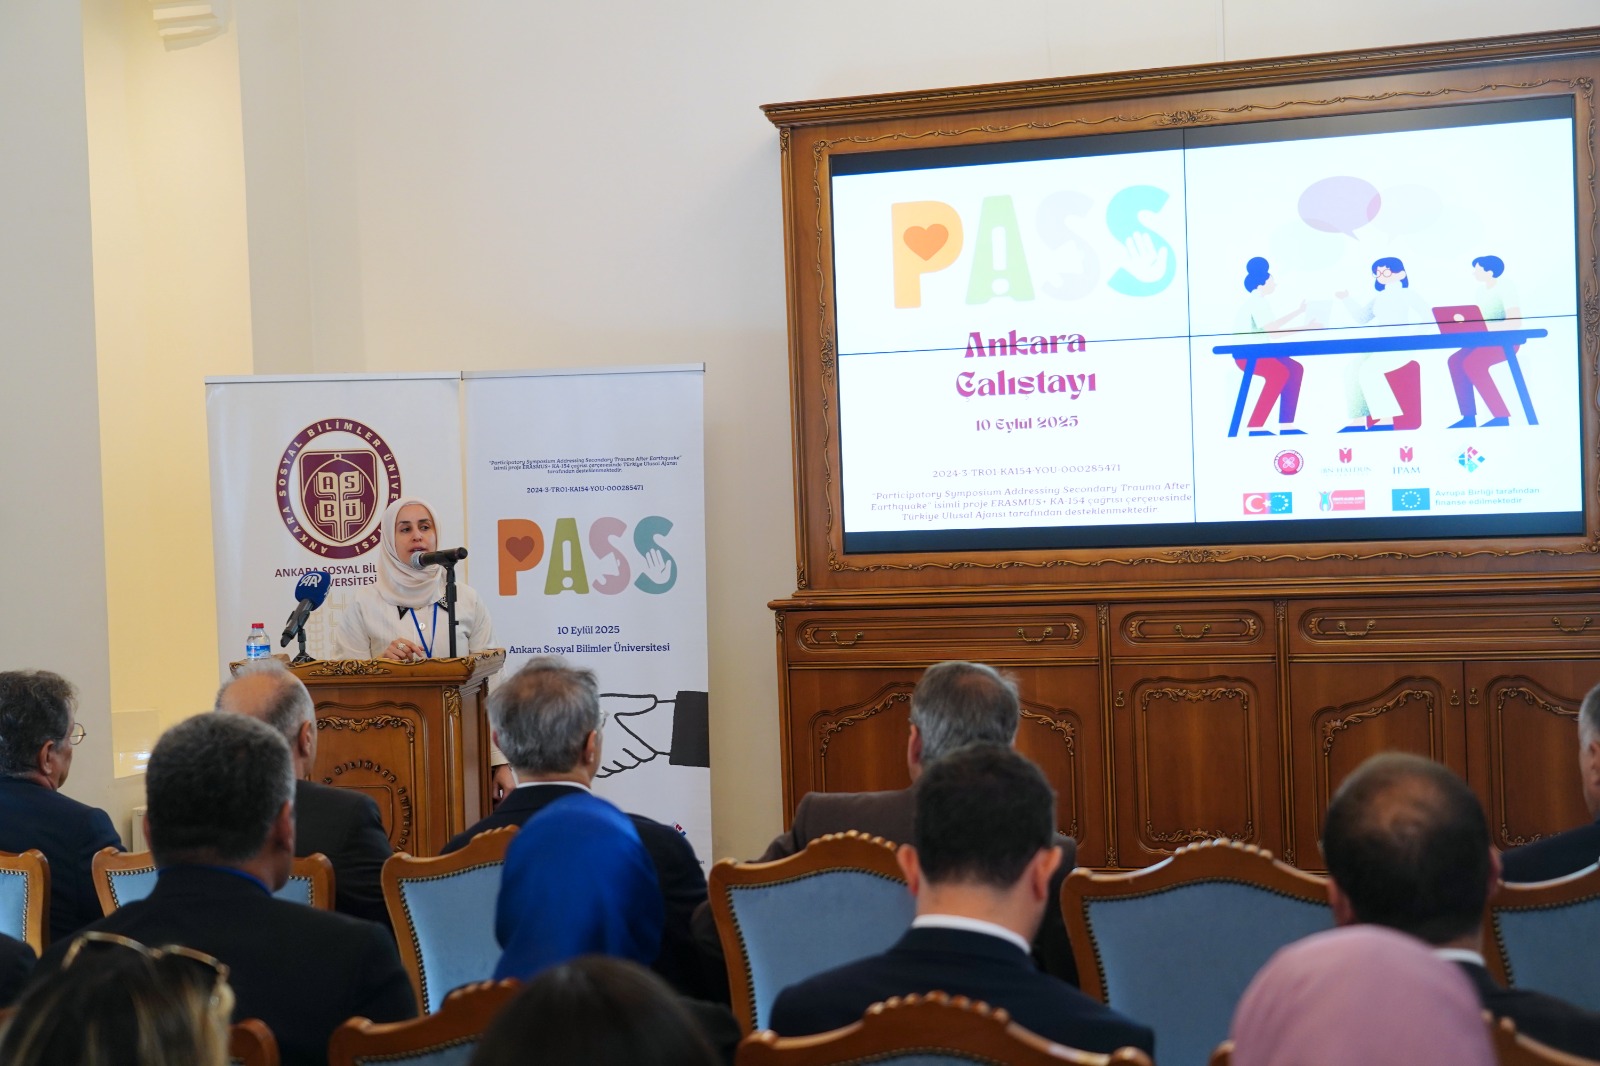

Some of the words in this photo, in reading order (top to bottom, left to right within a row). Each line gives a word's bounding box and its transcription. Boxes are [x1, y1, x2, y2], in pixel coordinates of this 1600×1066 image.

[891, 185, 1177, 309] PASS
[964, 329, 1086, 358] Ankara
[306, 419, 382, 448] BİLİMLER
[976, 419, 991, 431] 10
[995, 417, 1033, 434] Eylül
[1037, 415, 1079, 429] 2025
[278, 441, 302, 497] SOSYAL
[945, 488, 1002, 499] Symposium
[1004, 486, 1060, 496] Addressing
[1063, 484, 1118, 495] Secondary
[1121, 483, 1161, 492] Trauma
[1164, 482, 1191, 491] After
[1435, 490, 1466, 498] Avrupa
[934, 500, 960, 509] isimli
[963, 500, 988, 510] proje
[942, 511, 973, 520] Ulusal
[282, 506, 328, 555] ANKARA
[498, 516, 678, 596] PASS
[322, 564, 360, 575] SOSYAL
[557, 626, 569, 635] 10
[571, 625, 593, 637] Eylül
[595, 625, 620, 635] 2025
[509, 645, 542, 654] Ankara
[543, 643, 574, 656] Sosyal
[576, 643, 612, 653] Bilimler
[614, 642, 670, 653] Üniversitesi
